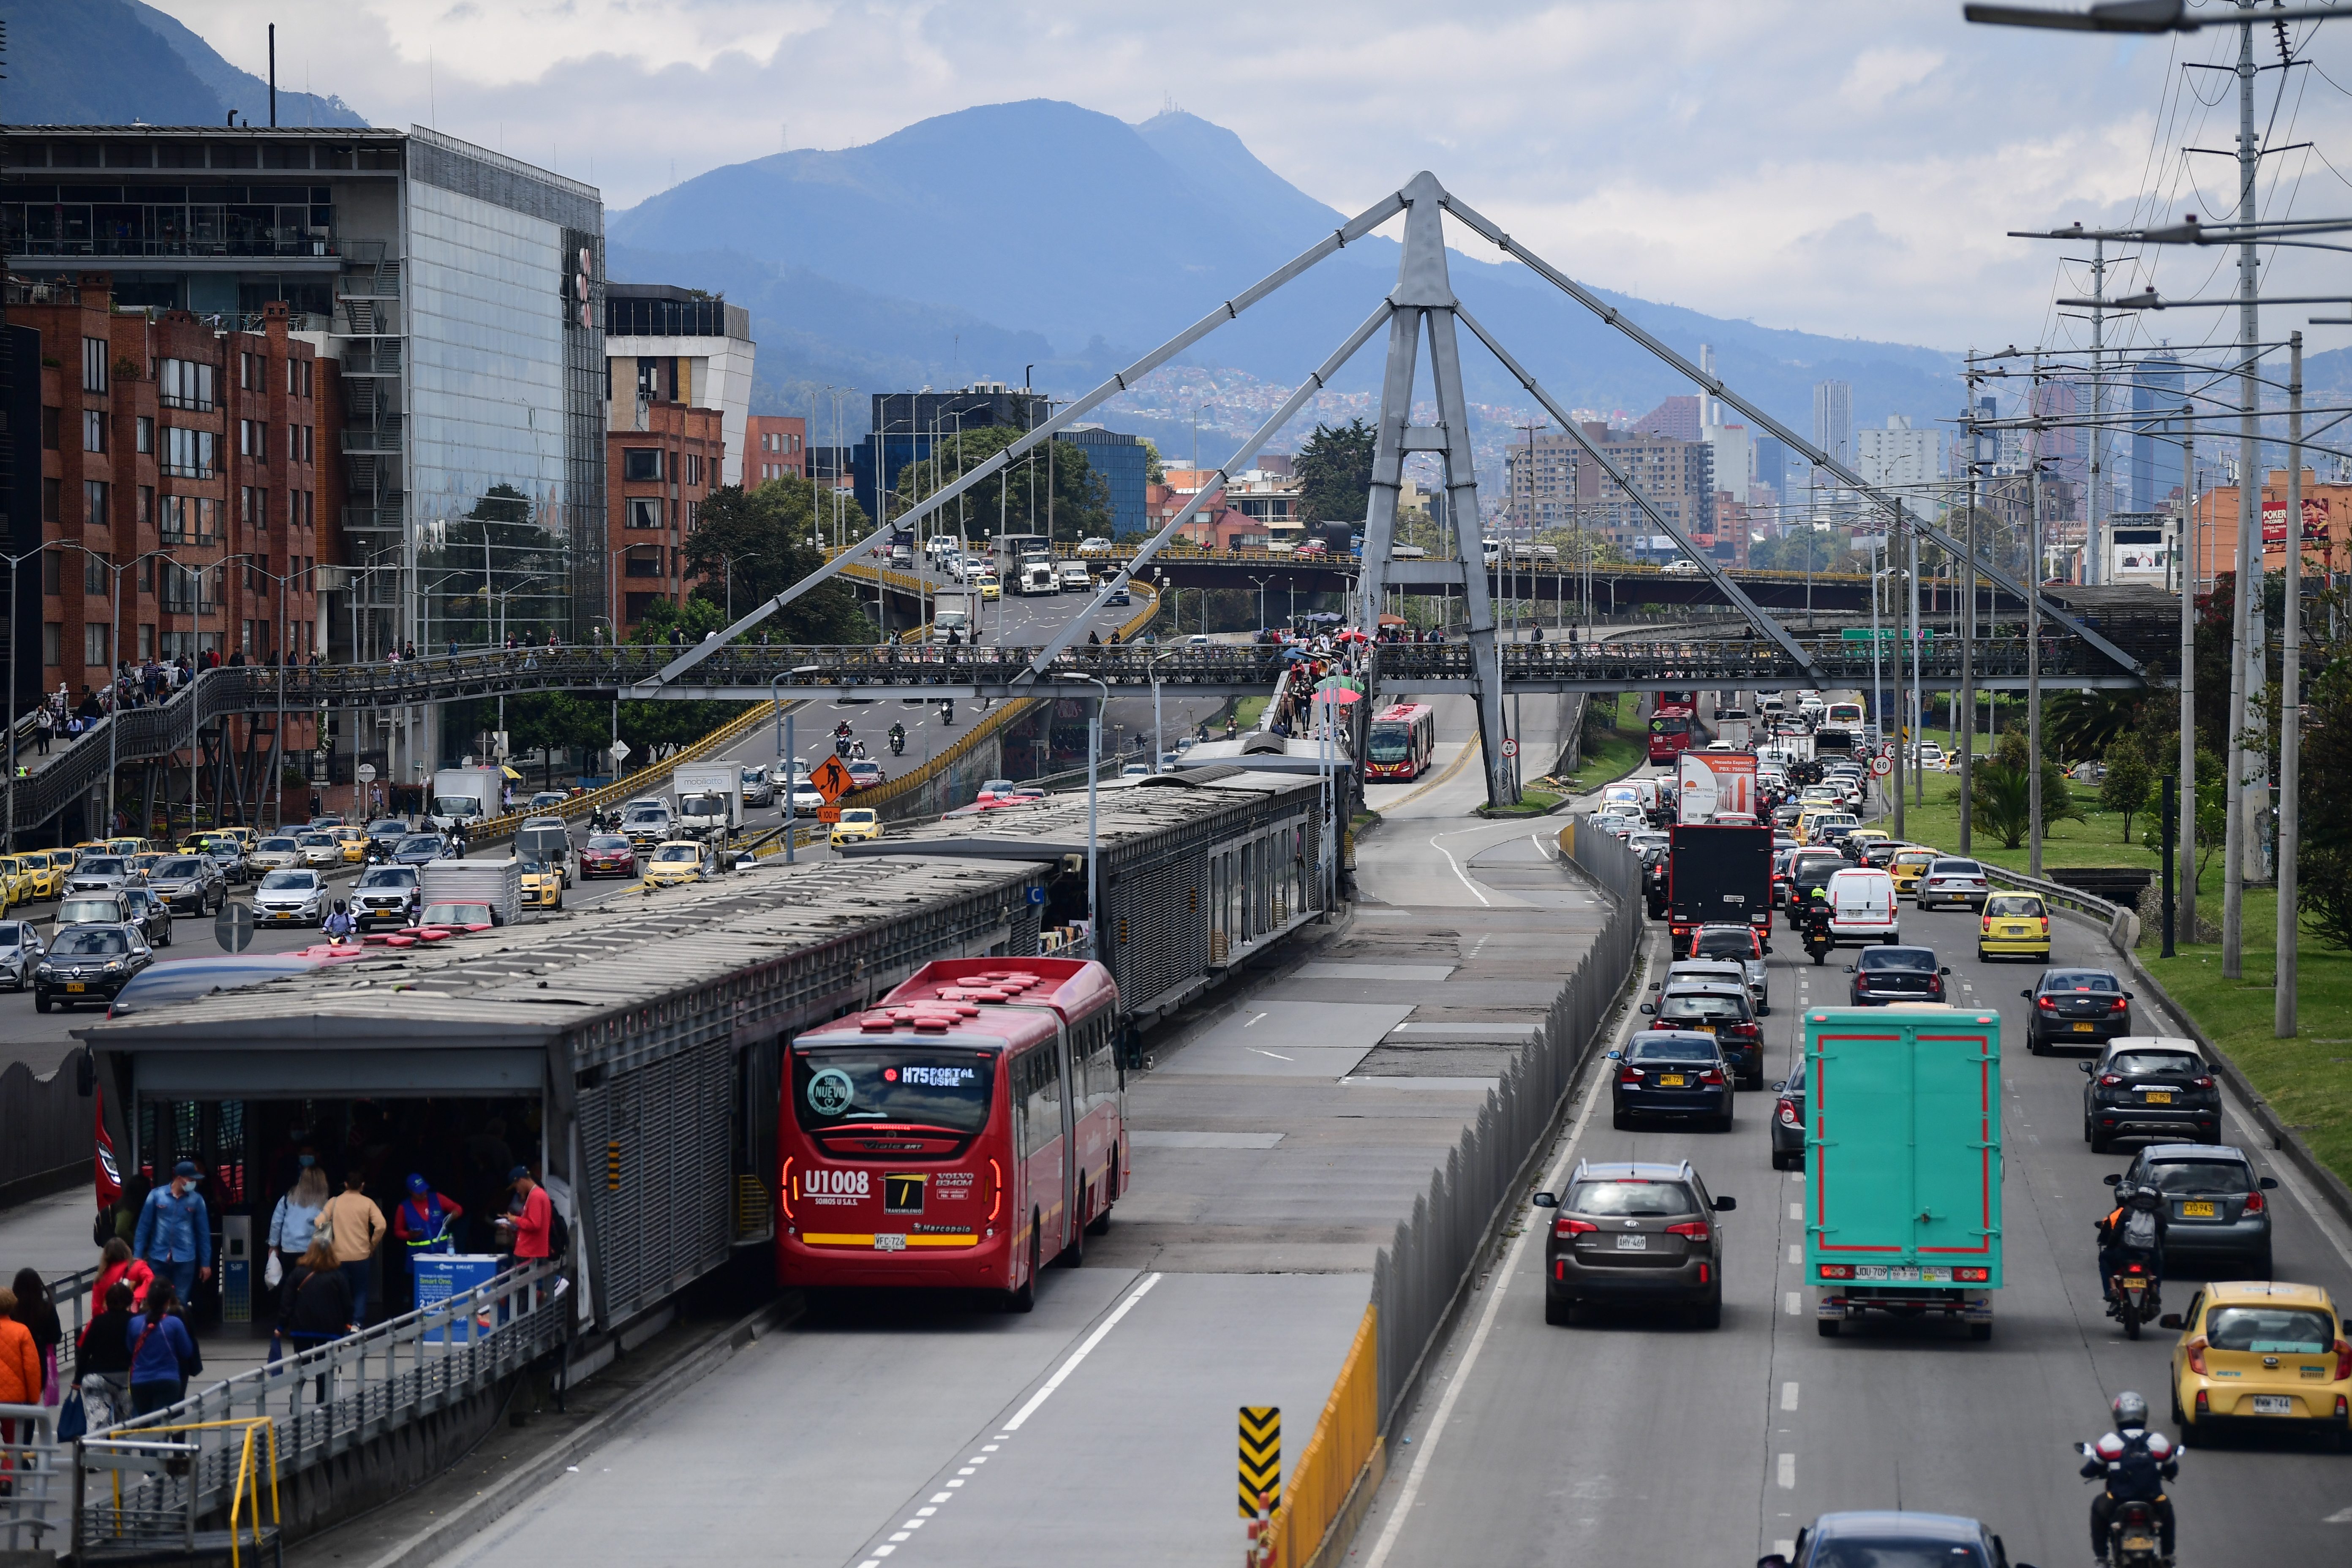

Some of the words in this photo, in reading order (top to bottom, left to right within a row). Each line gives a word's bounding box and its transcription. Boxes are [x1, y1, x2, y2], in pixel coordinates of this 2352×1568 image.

[2263, 509, 2286, 520] POKER
[1031, 888, 1040, 902] C
[902, 1067, 929, 1083] H75
[930, 1067, 975, 1078] PORTAL
[824, 1077, 837, 1086] SOY
[929, 1077, 960, 1086] USME
[815, 1086, 845, 1098] NUEVO
[806, 1170, 869, 1194] U1008
